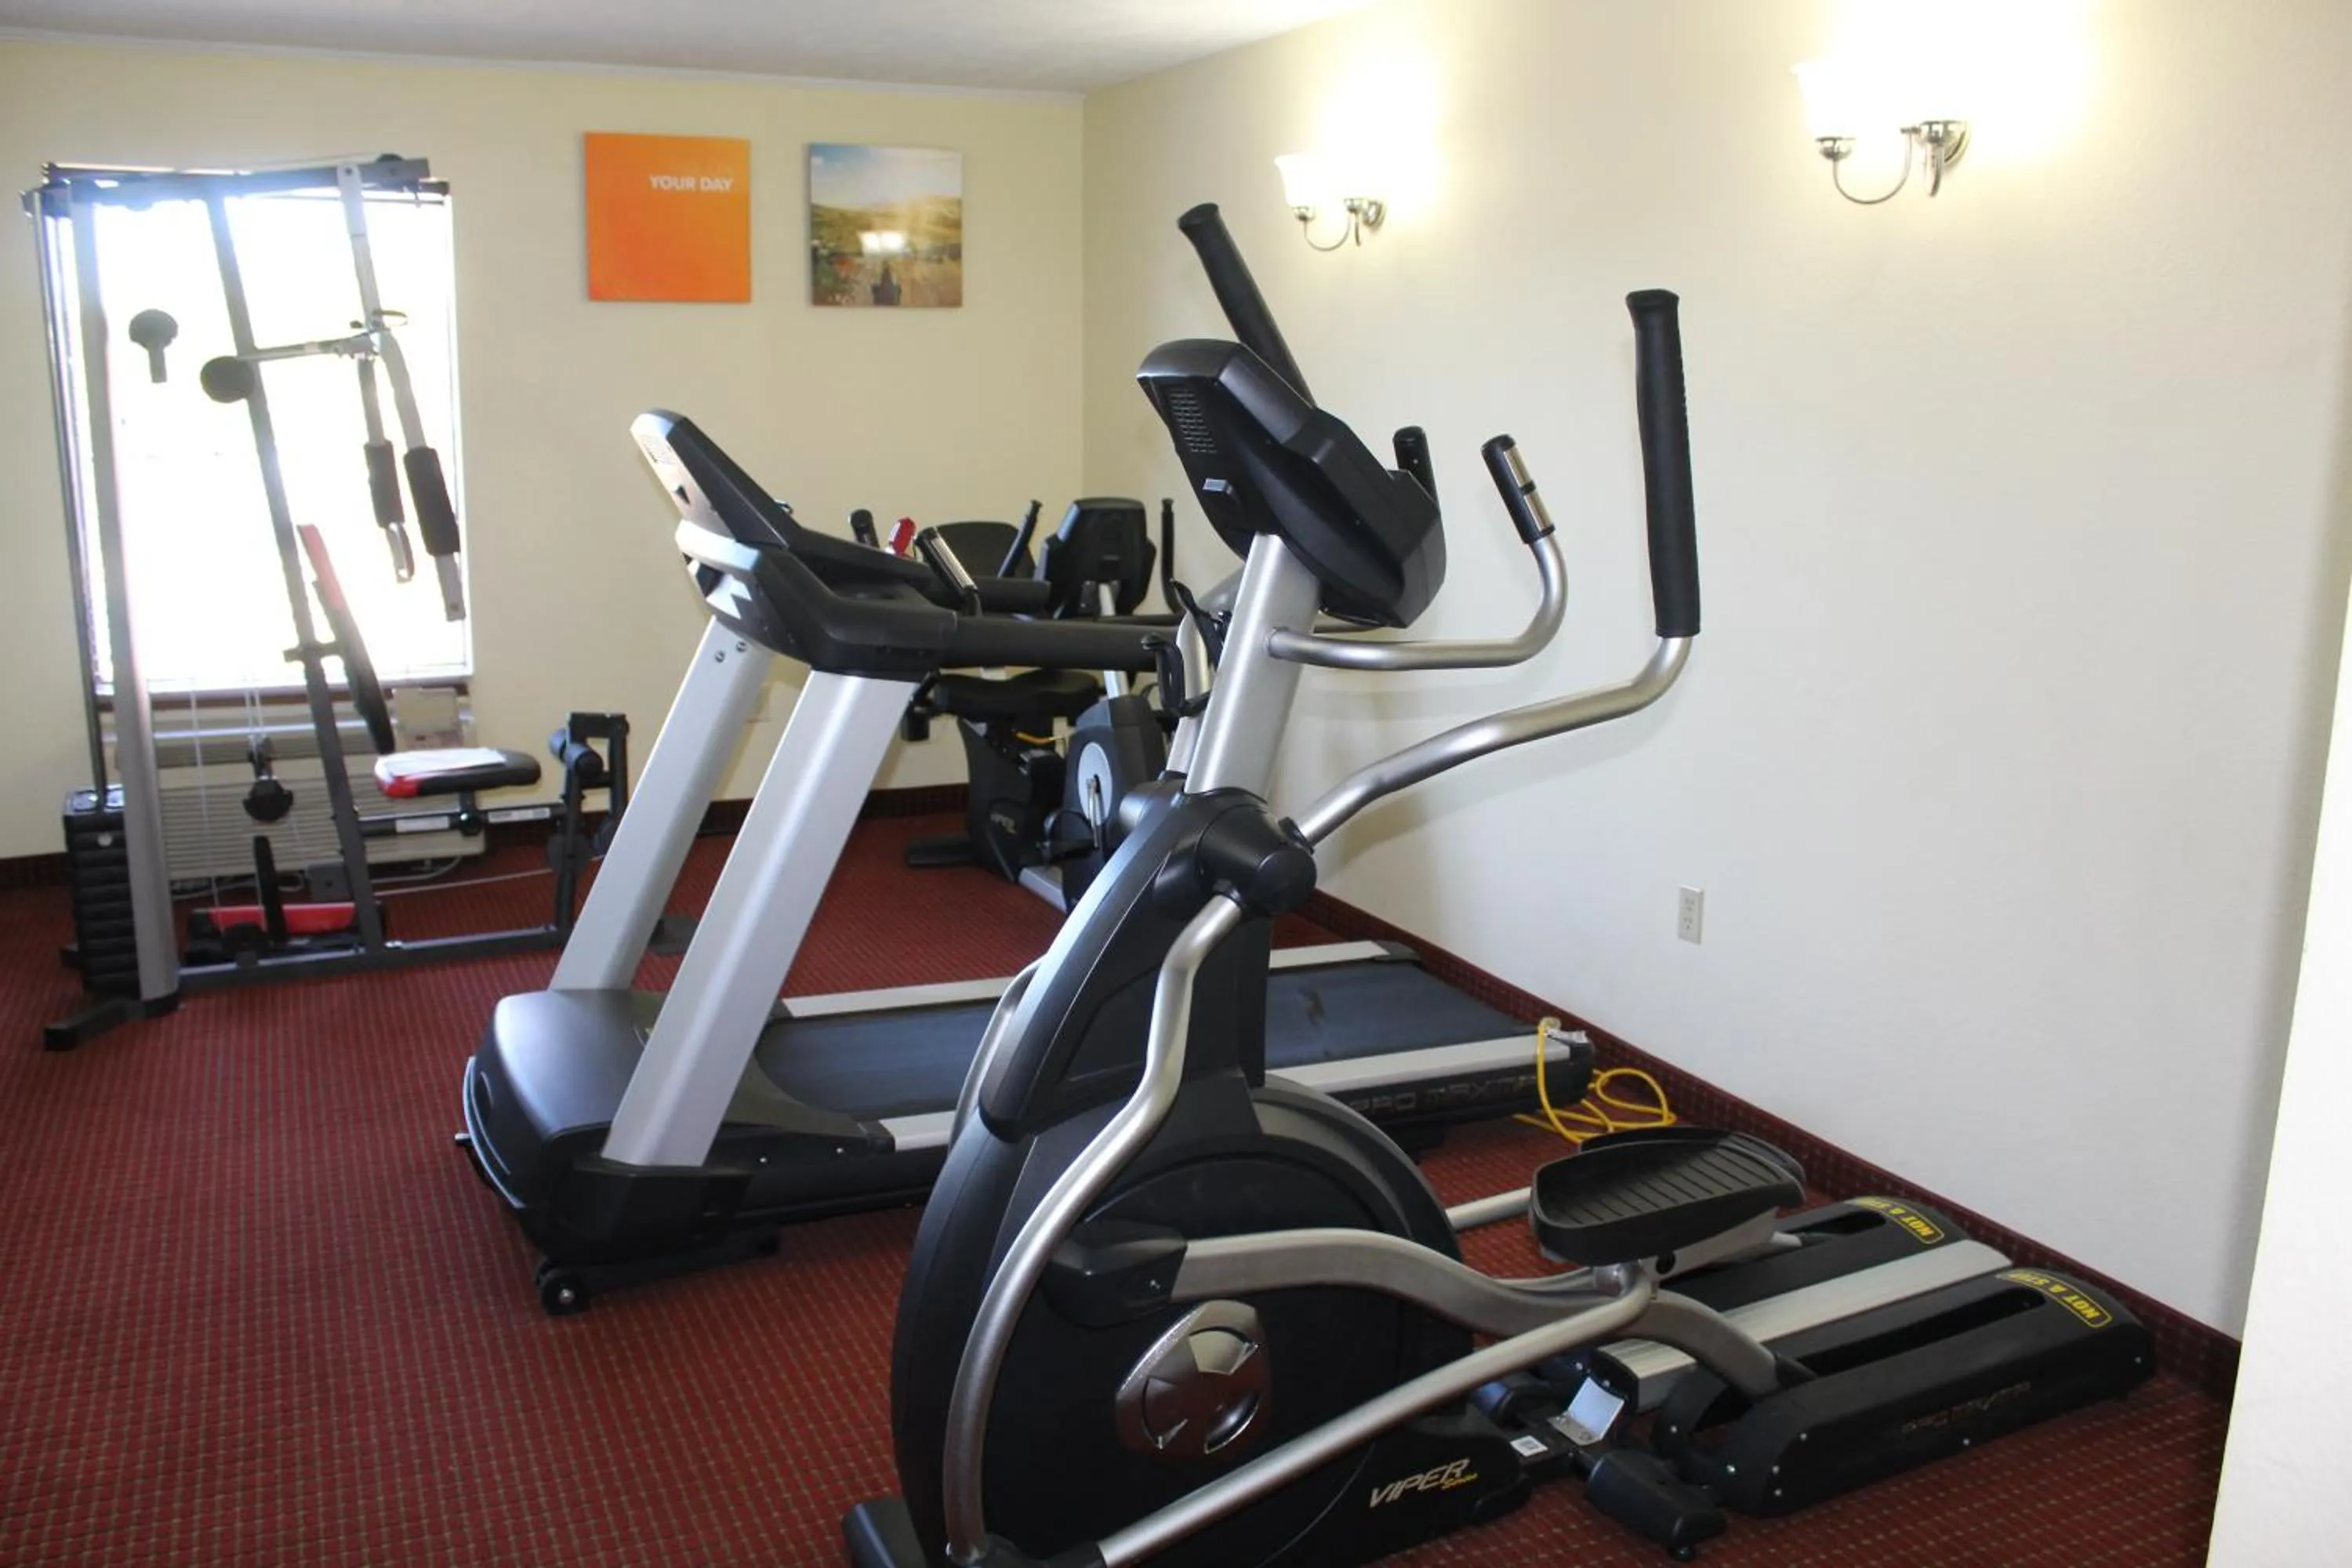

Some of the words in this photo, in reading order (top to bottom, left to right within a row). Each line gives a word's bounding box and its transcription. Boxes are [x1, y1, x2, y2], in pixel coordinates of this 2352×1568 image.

[648, 173, 695, 192] YOUR
[700, 176, 734, 193] DAY
[1370, 1457, 1471, 1508] VIPER
